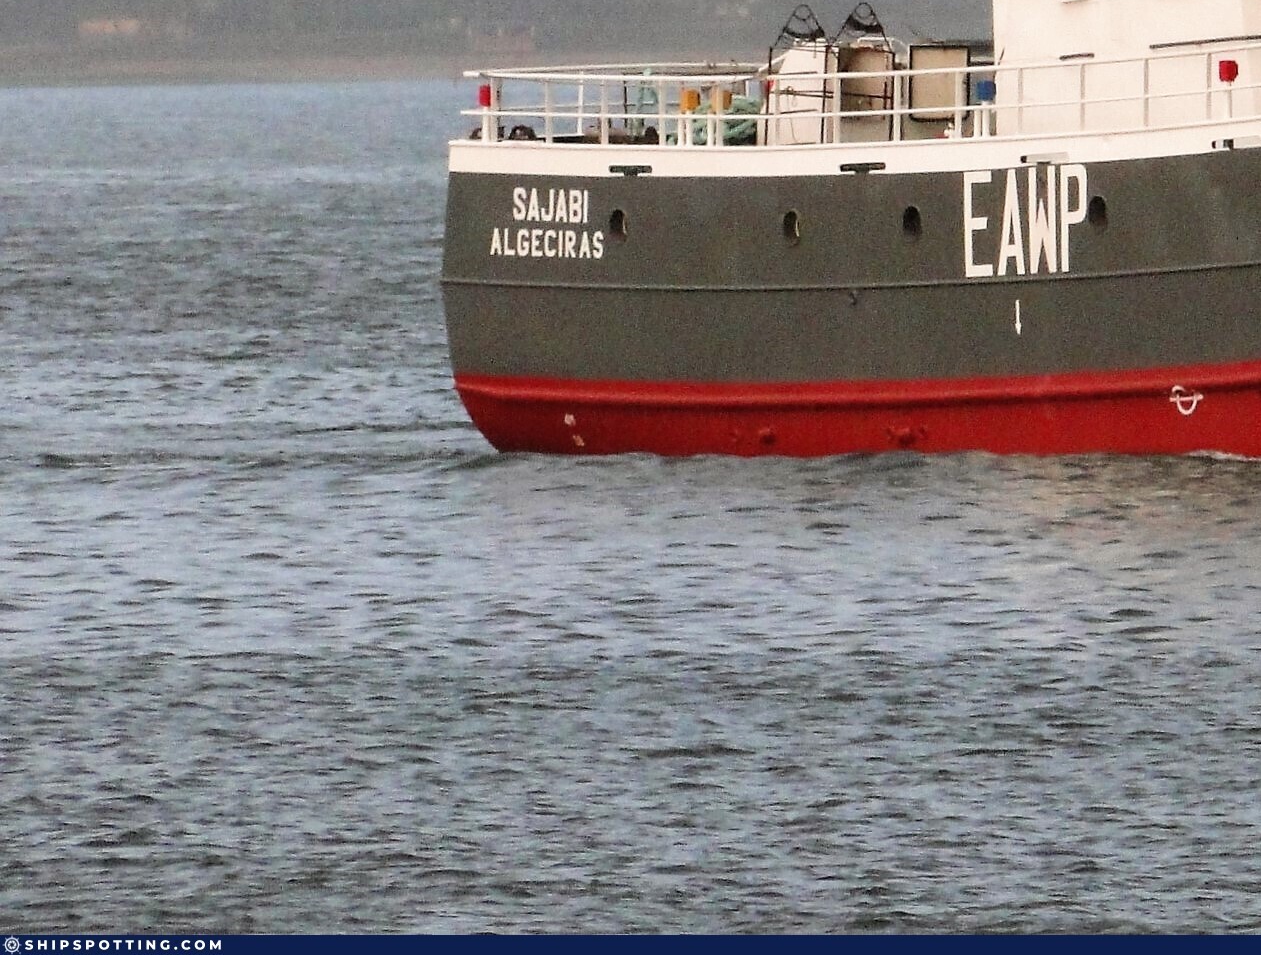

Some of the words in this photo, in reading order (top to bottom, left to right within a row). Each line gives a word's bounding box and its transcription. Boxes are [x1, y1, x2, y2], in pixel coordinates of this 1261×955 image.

[512, 187, 589, 223] SAJABI
[963, 163, 1088, 278] EAWP
[490, 228, 604, 259] ALGECIRAS
